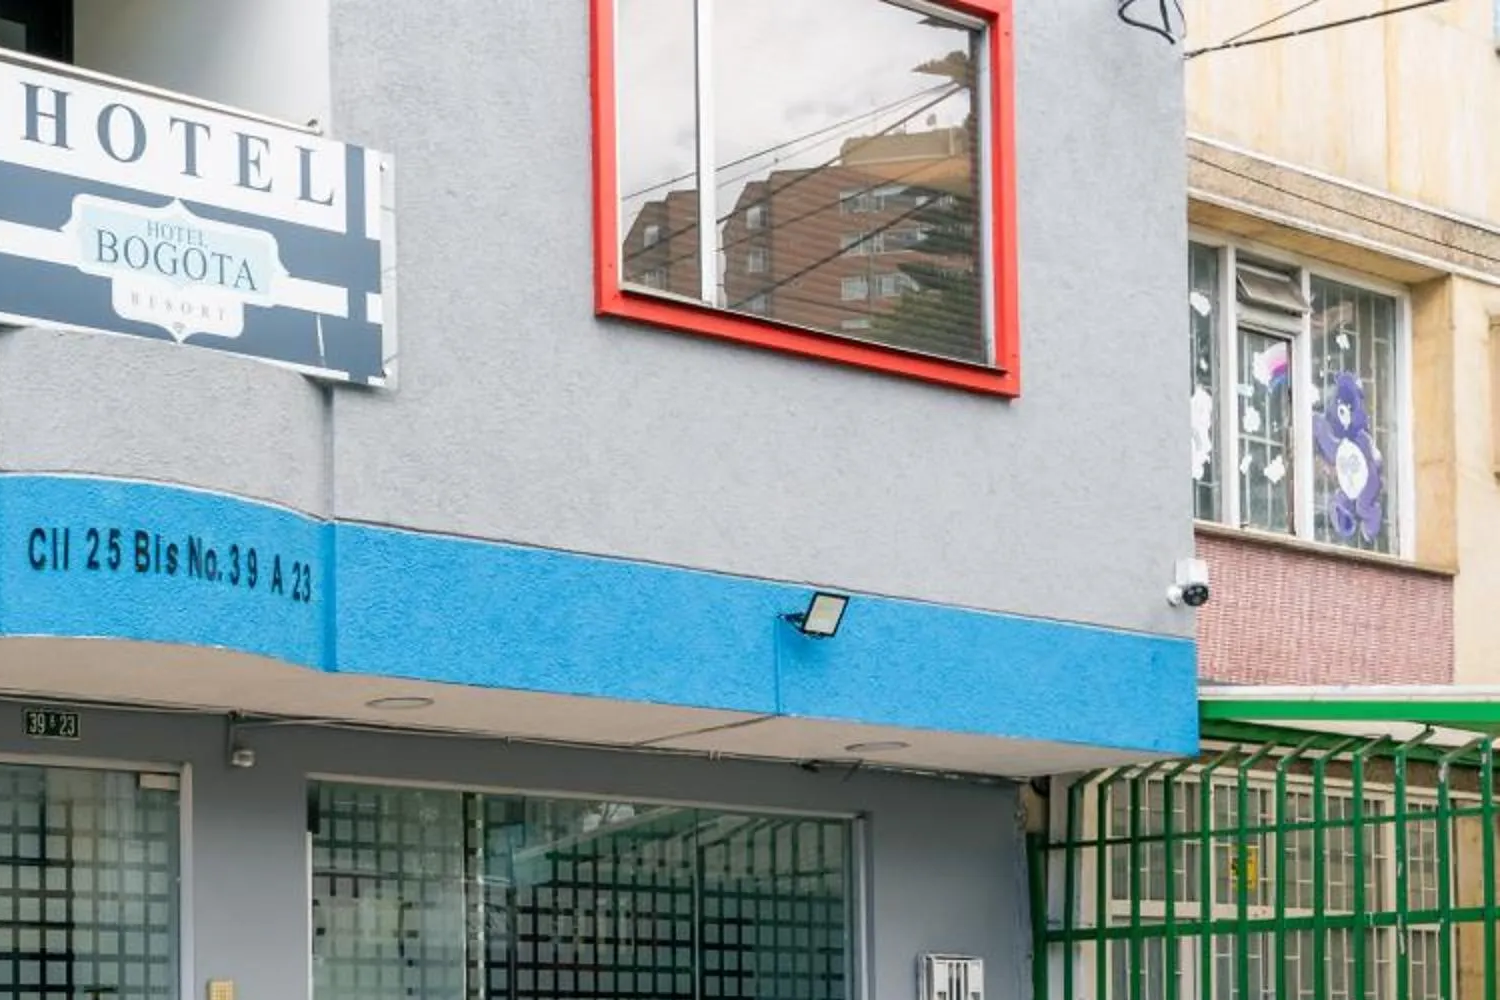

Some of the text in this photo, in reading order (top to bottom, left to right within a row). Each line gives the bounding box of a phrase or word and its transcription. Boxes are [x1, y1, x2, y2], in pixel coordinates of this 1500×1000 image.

[19, 81, 336, 207] HOTEL
[96, 228, 258, 292] BOGOTA
[147, 219, 208, 247] HOTEL
[86, 527, 122, 571] 25
[270, 552, 284, 595] A
[291, 560, 311, 604] 23
